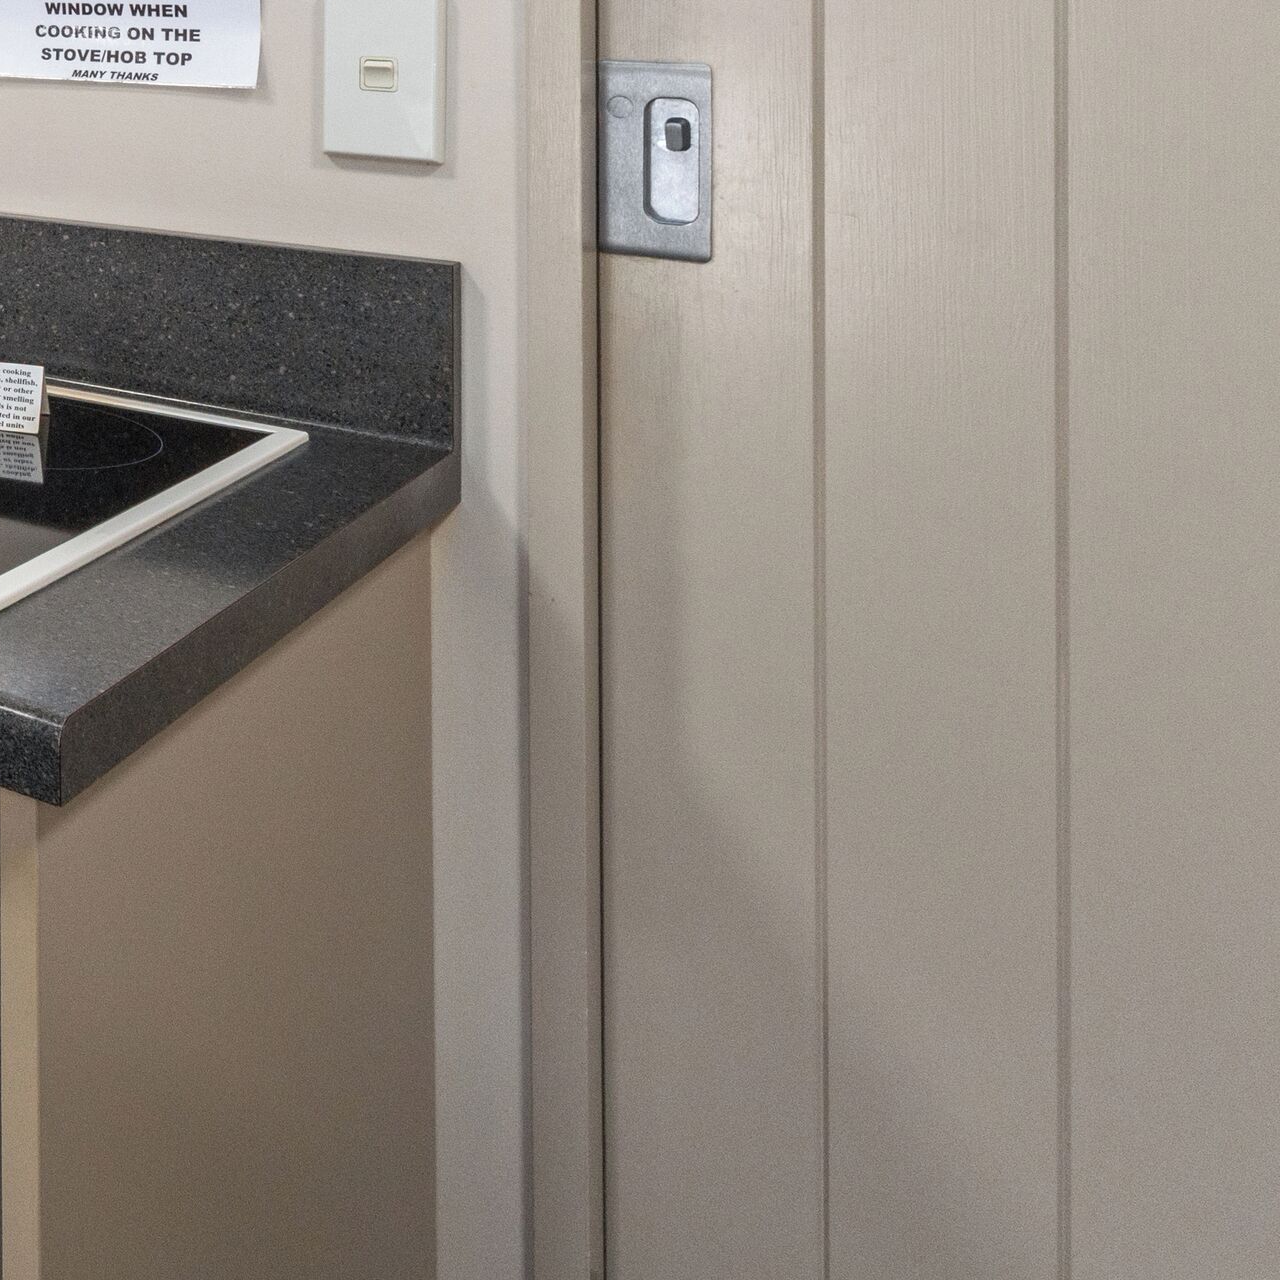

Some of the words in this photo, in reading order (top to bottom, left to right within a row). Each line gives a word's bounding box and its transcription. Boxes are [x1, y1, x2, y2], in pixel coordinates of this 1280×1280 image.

[45, 2, 124, 16] WINDOW
[129, 3, 188, 18] WHEN
[35, 24, 121, 39] COOKING
[127, 27, 154, 40] ON
[161, 28, 201, 42] THE
[41, 48, 146, 64] STOVE/HOB
[153, 52, 193, 66] TOP
[72, 69, 106, 79] MANY
[111, 71, 159, 81] THANKS
[2, 369, 31, 377] cooking
[3, 396, 34, 405] smelling
